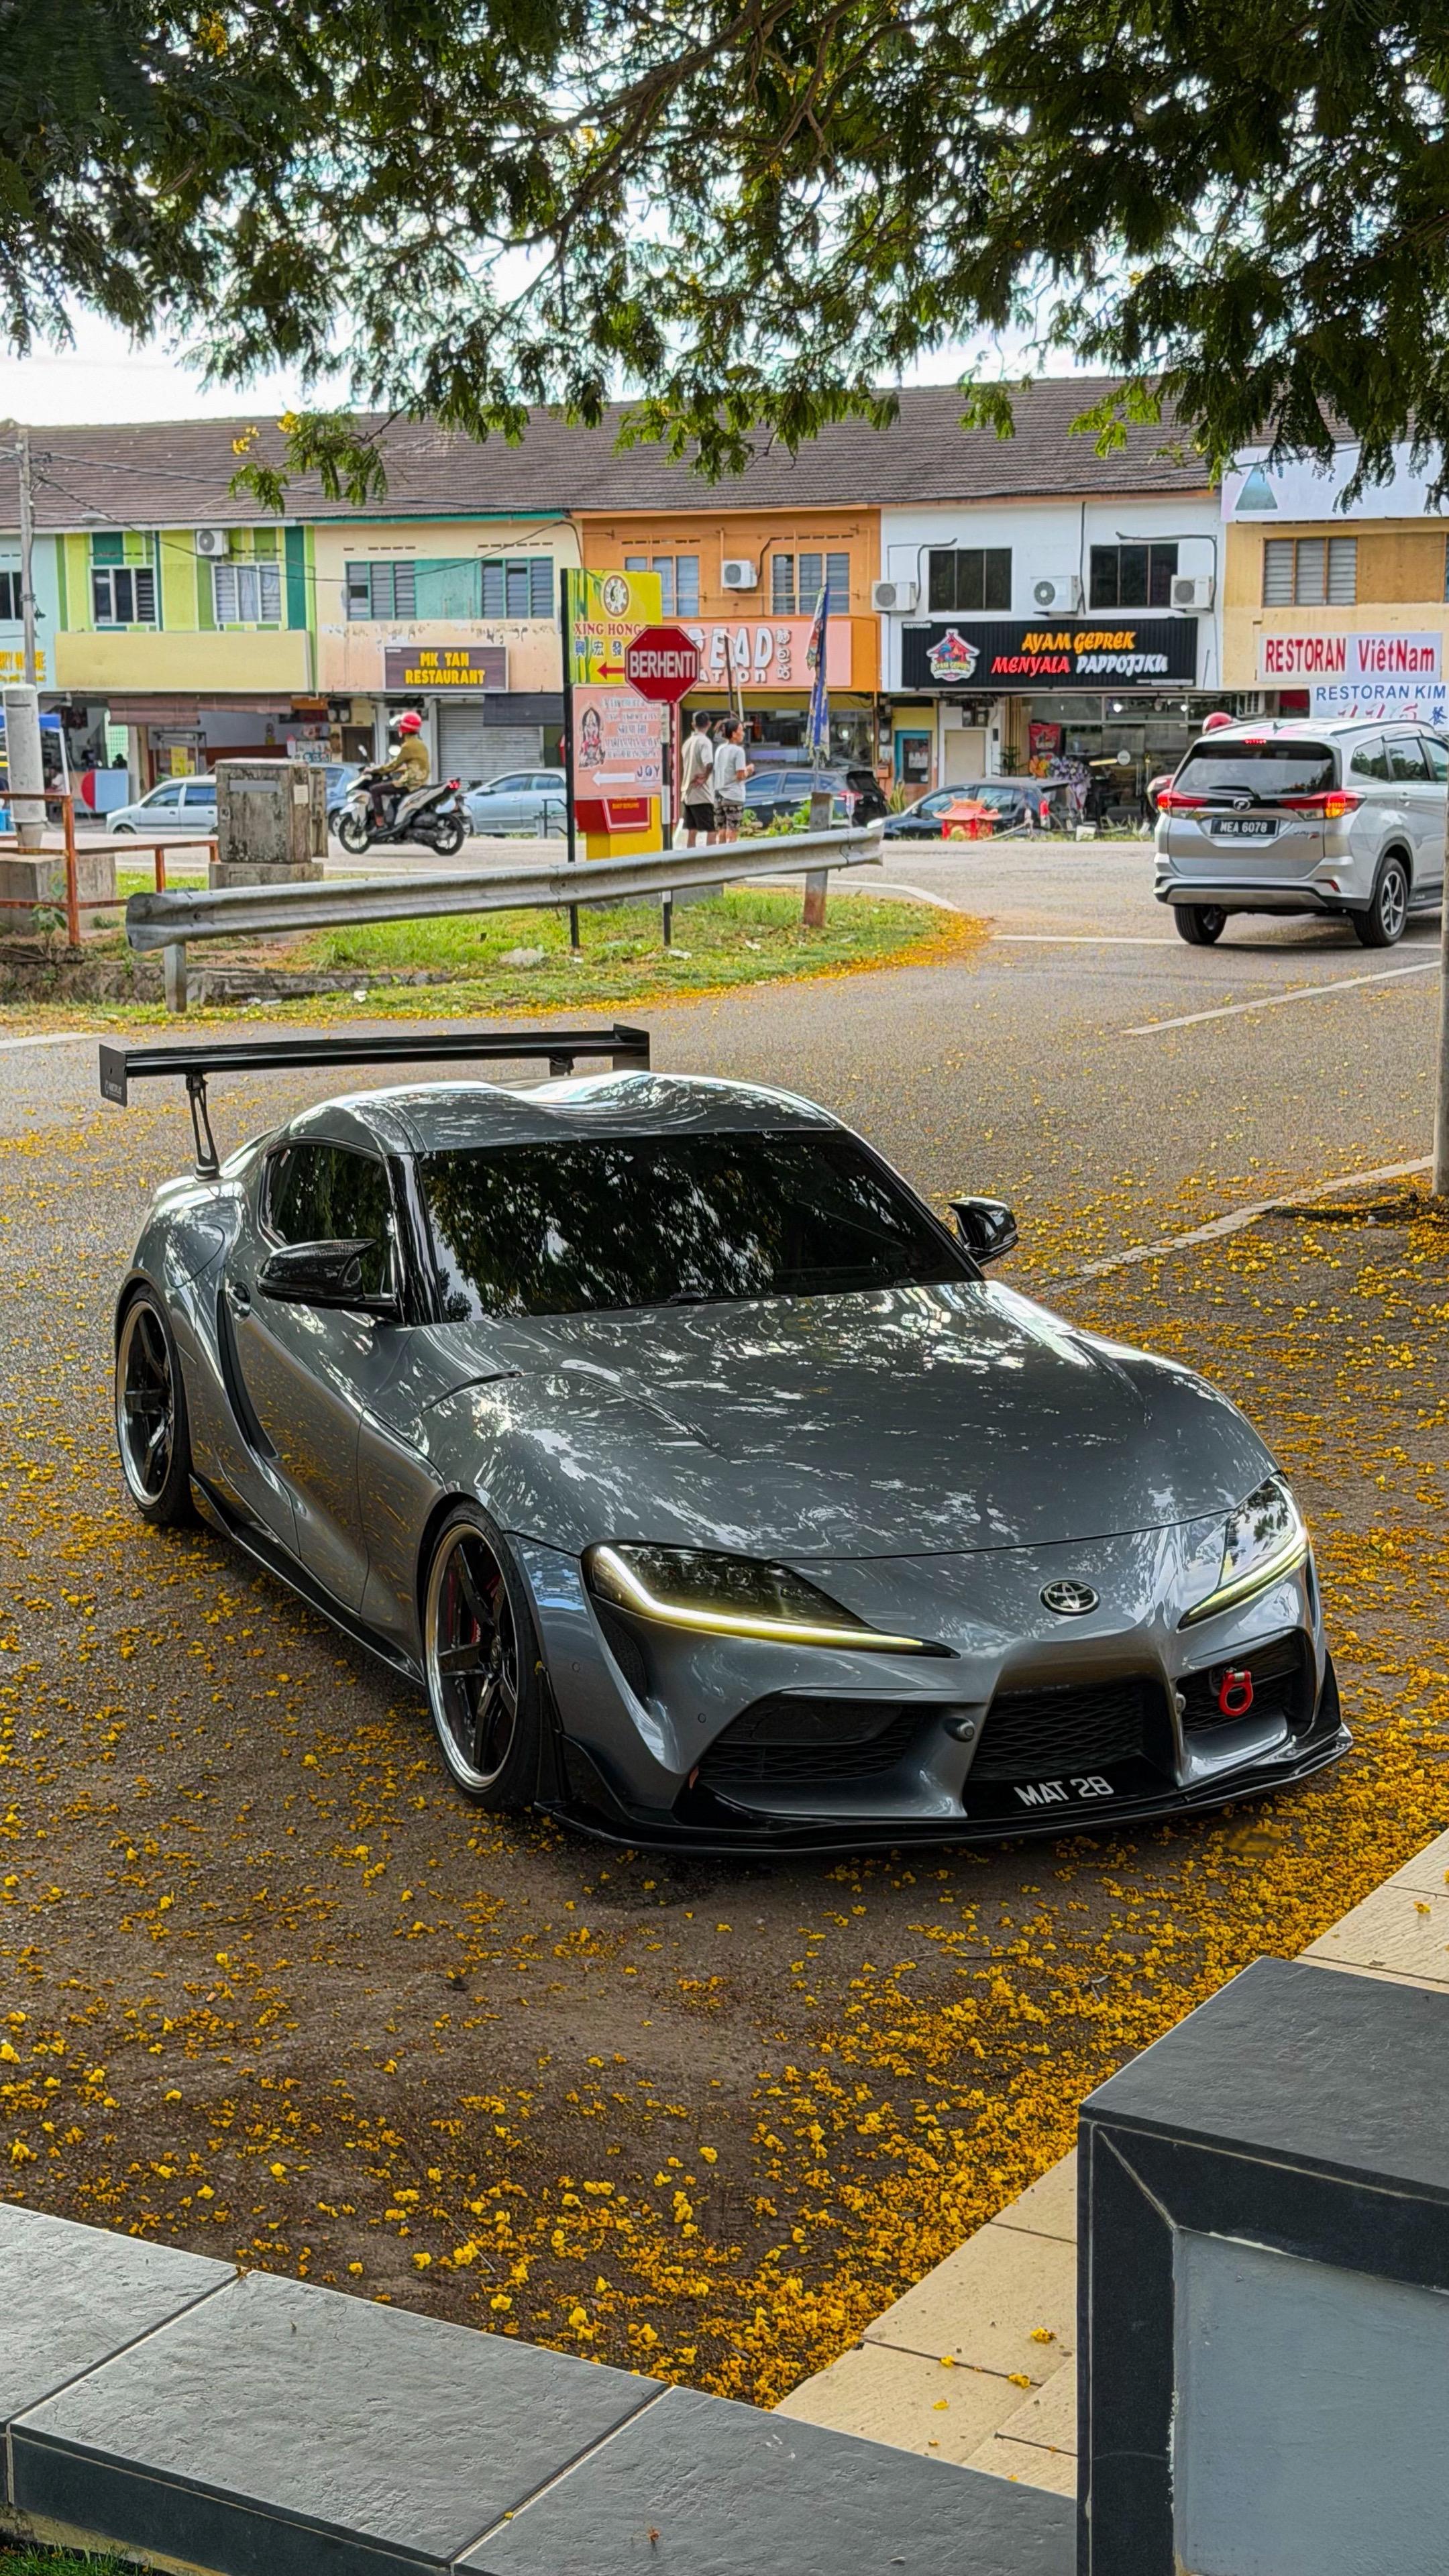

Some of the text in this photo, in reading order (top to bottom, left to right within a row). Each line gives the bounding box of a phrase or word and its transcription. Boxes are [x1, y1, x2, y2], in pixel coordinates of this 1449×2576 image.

[574, 623, 642, 635] XING HONG
[1022, 631, 1136, 654] AYAM GEPREK
[420, 652, 470, 667] MK TAN
[1265, 638, 1346, 673] RESTORAN
[629, 651, 696, 679] BERHENTI
[991, 656, 1071, 677] MENYALA
[405, 669, 486, 684] RESTAURANT
[1316, 685, 1446, 701] RESTORAN KIM
[1242, 821, 1268, 833] 6078
[1014, 1776, 1114, 1806] MAT 28
